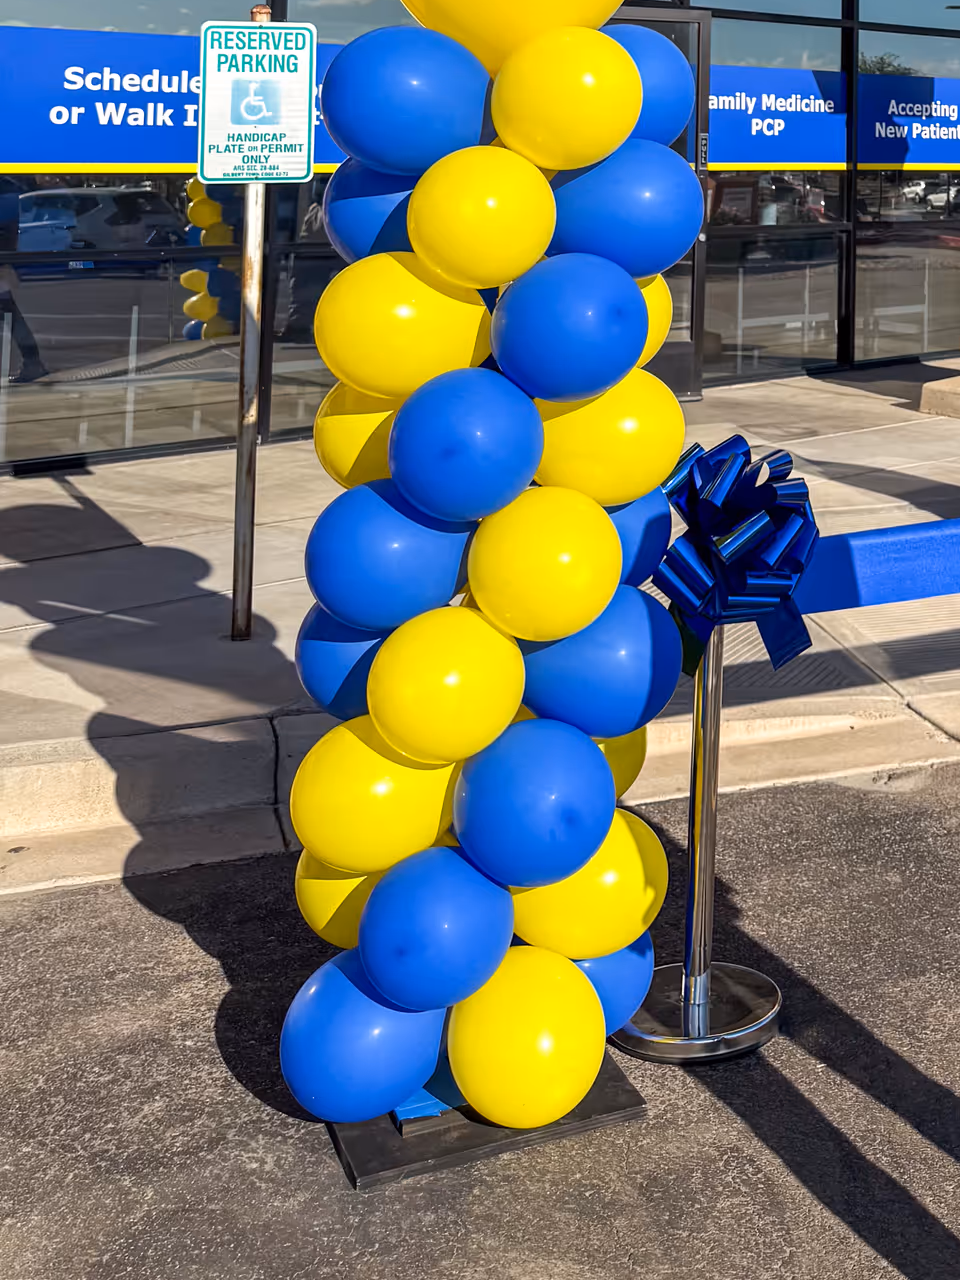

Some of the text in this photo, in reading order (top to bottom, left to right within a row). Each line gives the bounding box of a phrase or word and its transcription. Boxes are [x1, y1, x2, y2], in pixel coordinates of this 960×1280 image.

[210, 31, 306, 50] RESERVED
[217, 54, 298, 73] PARKING
[63, 66, 201, 93] Schedule
[708, 92, 835, 115] amily Medicine
[888, 99, 958, 121] Accepting
[49, 102, 199, 126] or Walk I
[751, 118, 785, 136] PCP
[875, 122, 908, 138] New
[227, 133, 286, 142] HANDICAP
[208, 144, 245, 154] PLATE
[260, 143, 304, 153] PERMIT
[242, 154, 271, 164] ONLY
